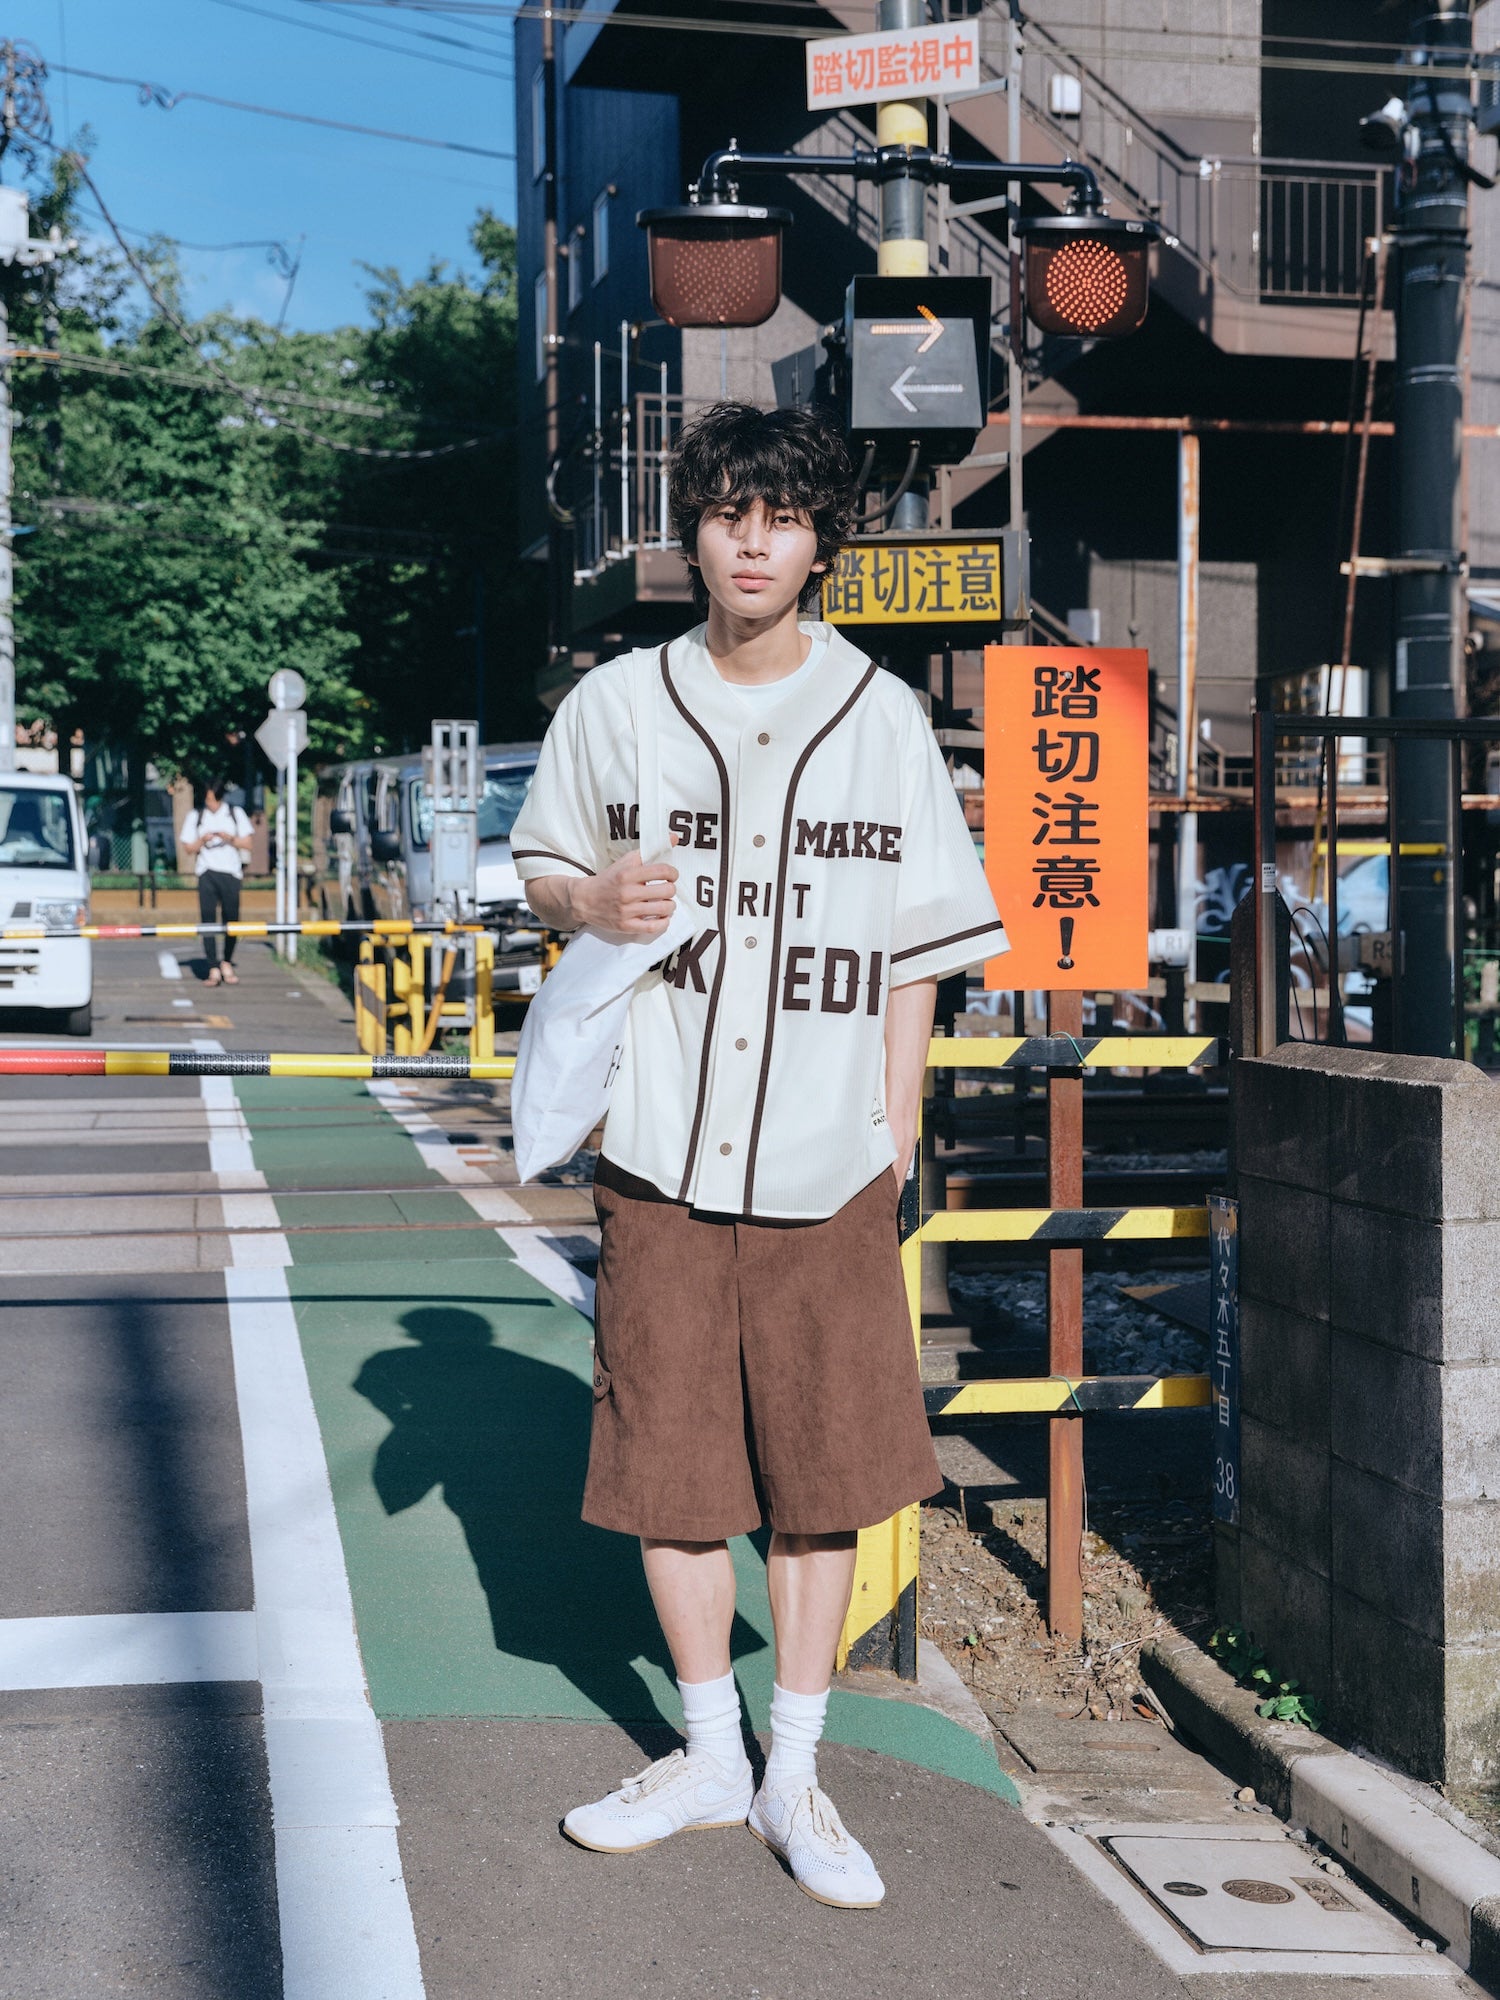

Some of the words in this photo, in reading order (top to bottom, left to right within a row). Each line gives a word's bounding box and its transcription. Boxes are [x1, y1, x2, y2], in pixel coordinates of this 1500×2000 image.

[812, 34, 973, 96] 踏切監視中
[826, 547, 997, 615] 踏切注意
[1032, 665, 1101, 970] 踏切注意！
[1217, 1227, 1232, 1428] 代々木五丁目
[1216, 1456, 1236, 1500] 38
